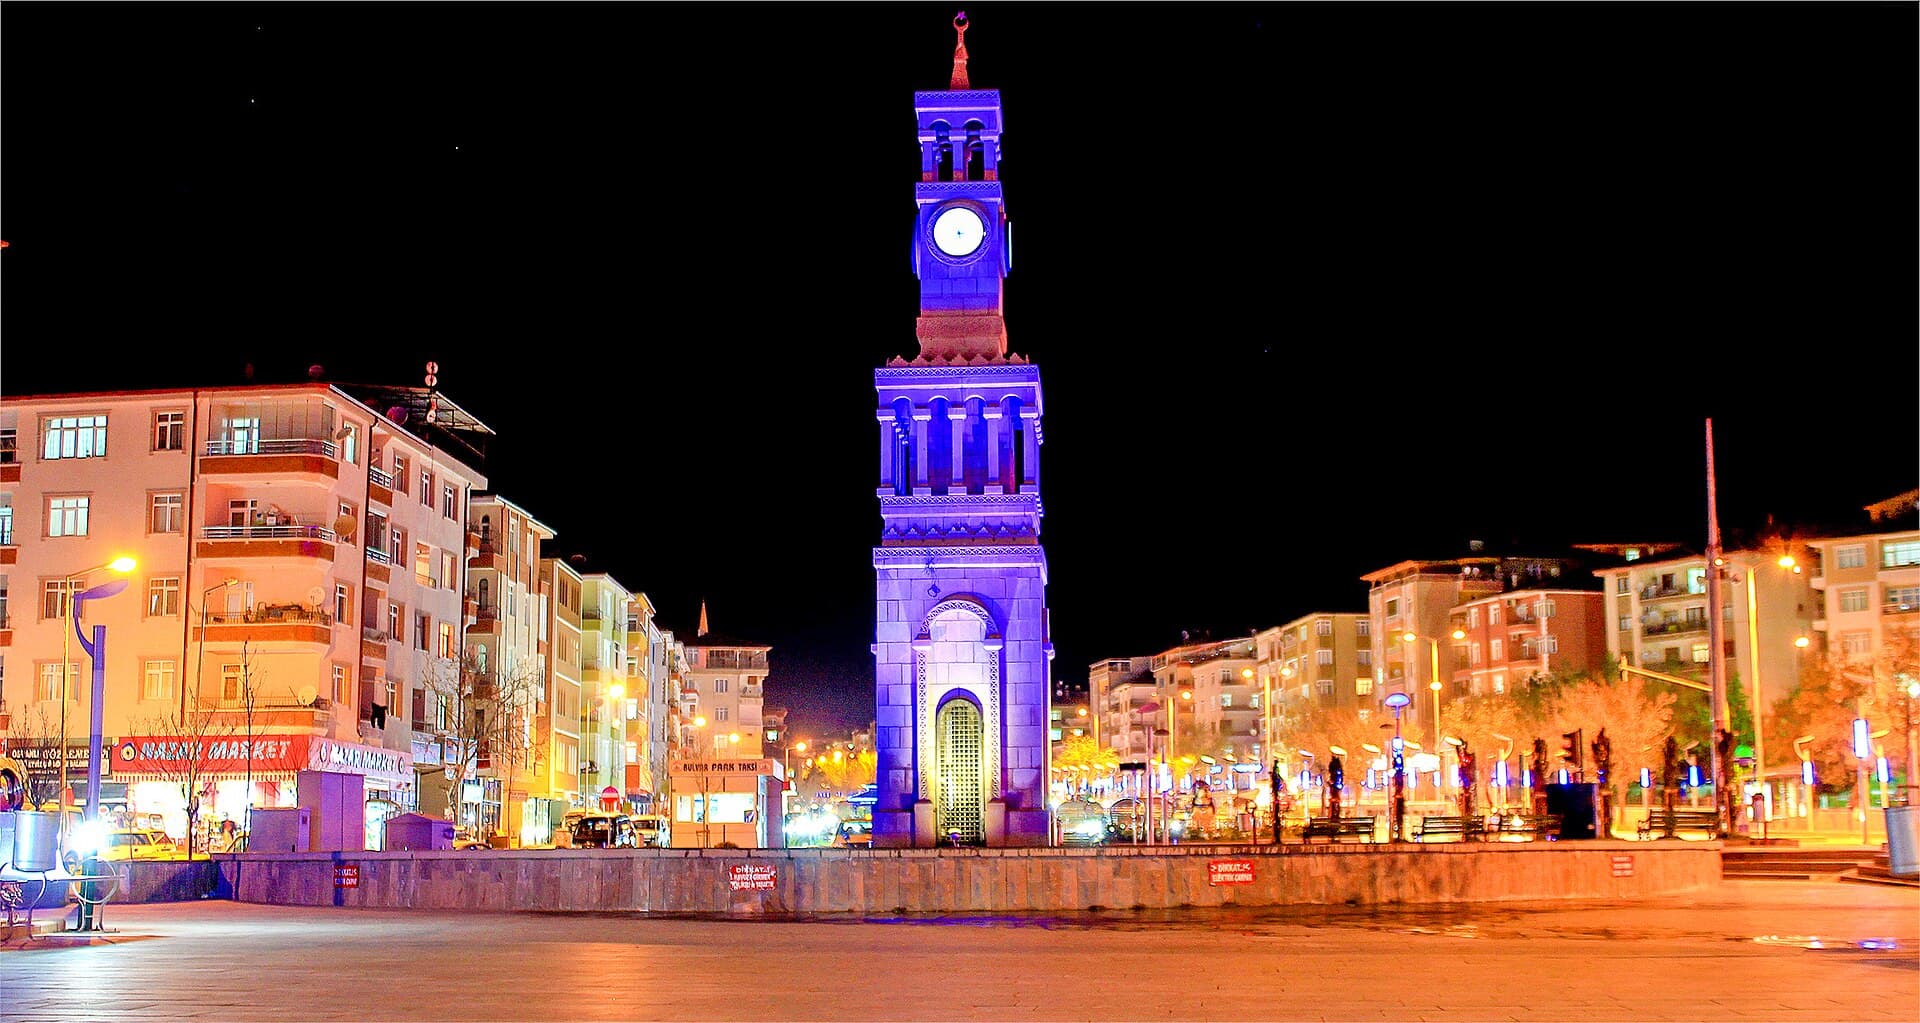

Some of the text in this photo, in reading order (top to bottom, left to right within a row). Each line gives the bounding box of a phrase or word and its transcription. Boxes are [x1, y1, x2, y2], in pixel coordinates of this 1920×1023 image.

[42, 747, 89, 760] GÖZEME
[139, 741, 291, 761] NAZAR MARKET
[329, 743, 398, 772] NAZAR MARKET
[711, 763, 735, 772] PARK
